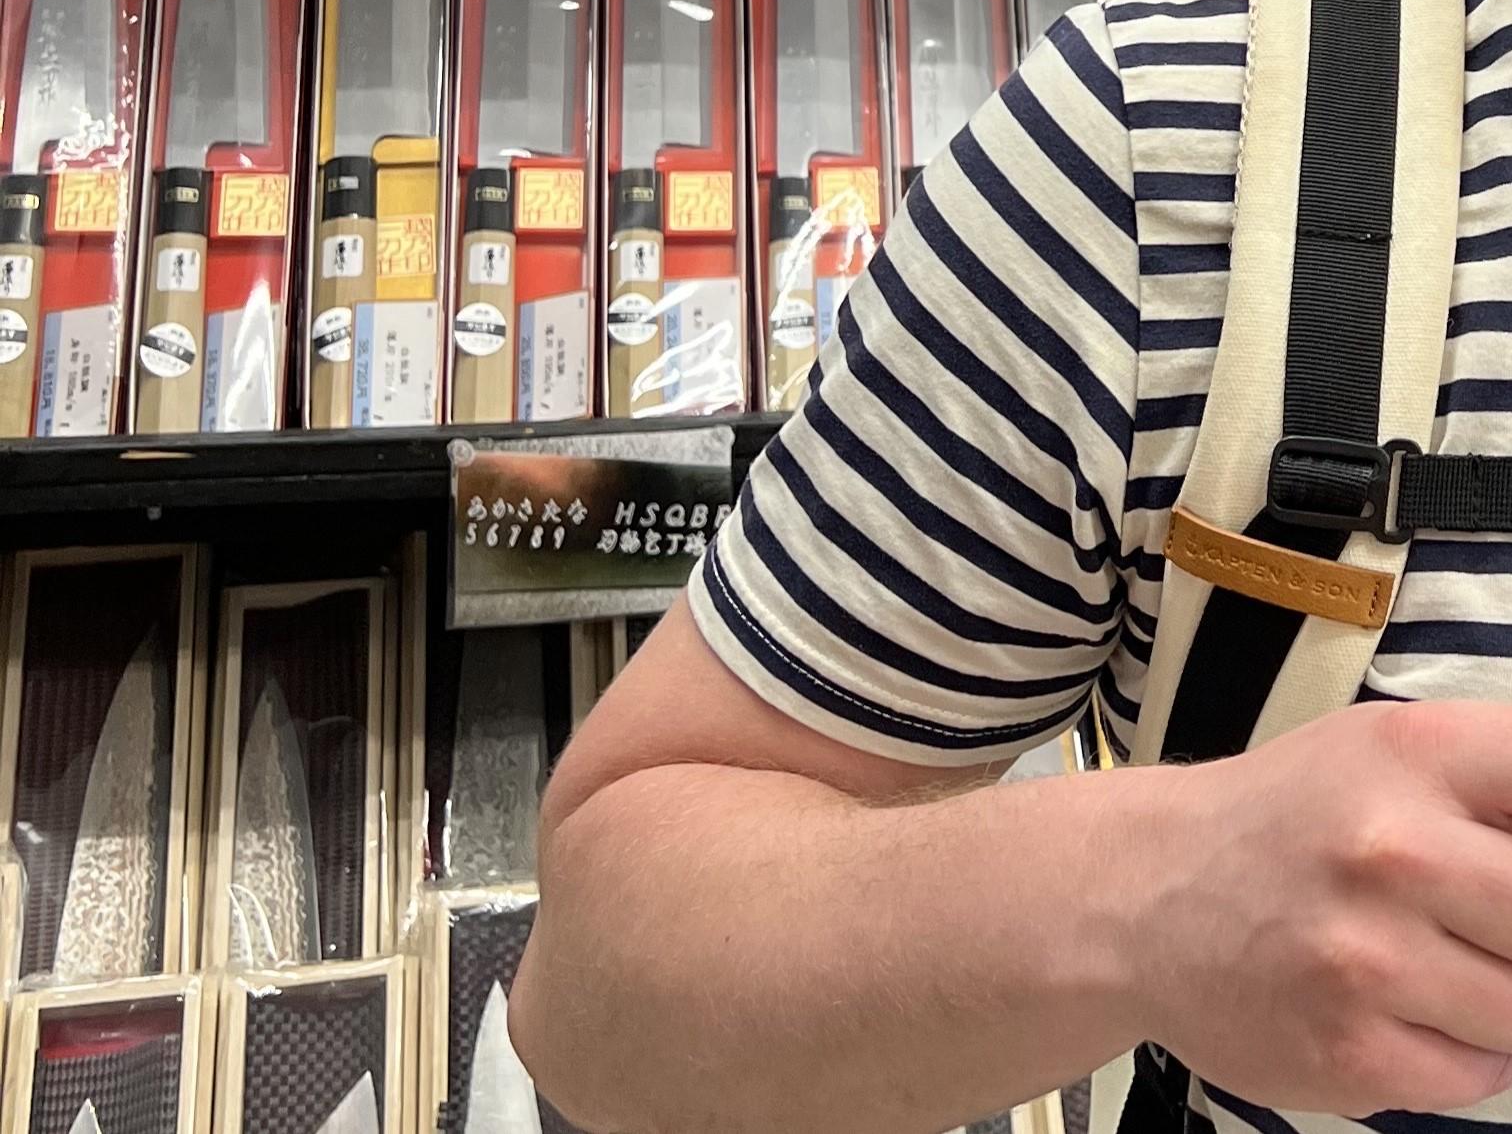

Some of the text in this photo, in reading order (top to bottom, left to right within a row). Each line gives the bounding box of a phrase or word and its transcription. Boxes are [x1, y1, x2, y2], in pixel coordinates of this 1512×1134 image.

[1201, 544, 1361, 604] KAPTEN & SON
